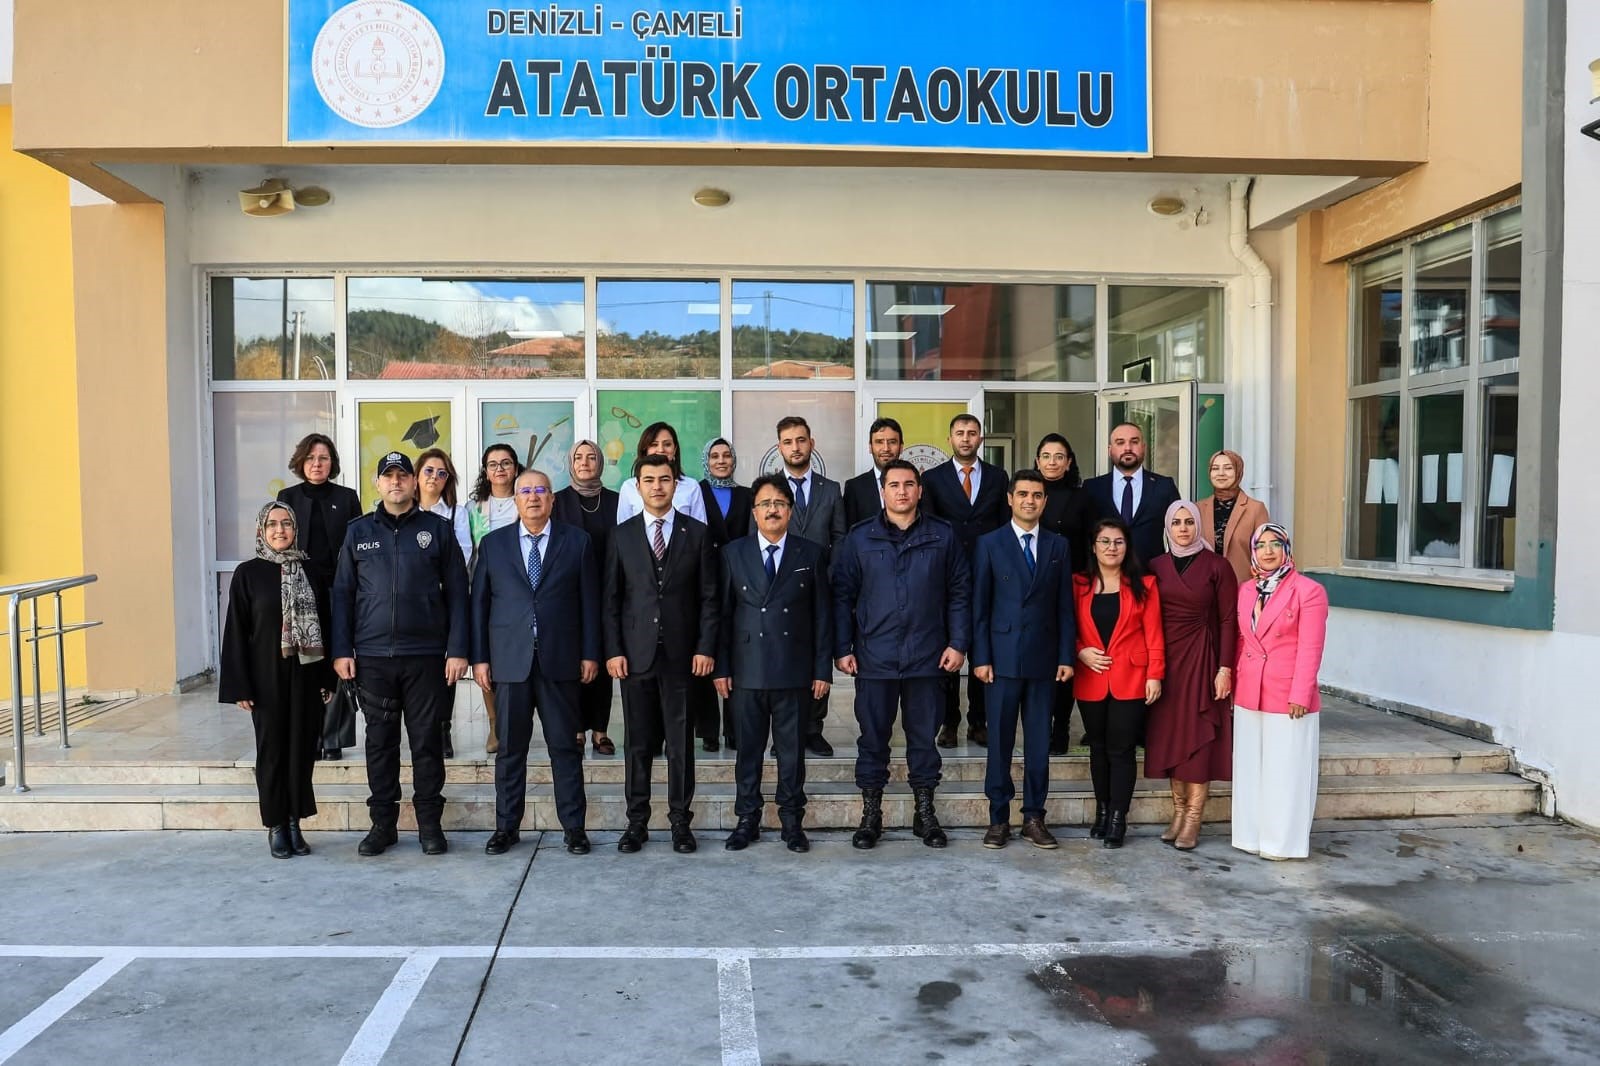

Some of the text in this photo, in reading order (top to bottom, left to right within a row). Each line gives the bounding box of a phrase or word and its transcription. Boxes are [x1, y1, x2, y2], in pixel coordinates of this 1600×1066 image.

[487, 4, 744, 40] DENİZLİ - ÇAMELİ
[485, 45, 1114, 129] ATATÜRK ORTAOKULU
